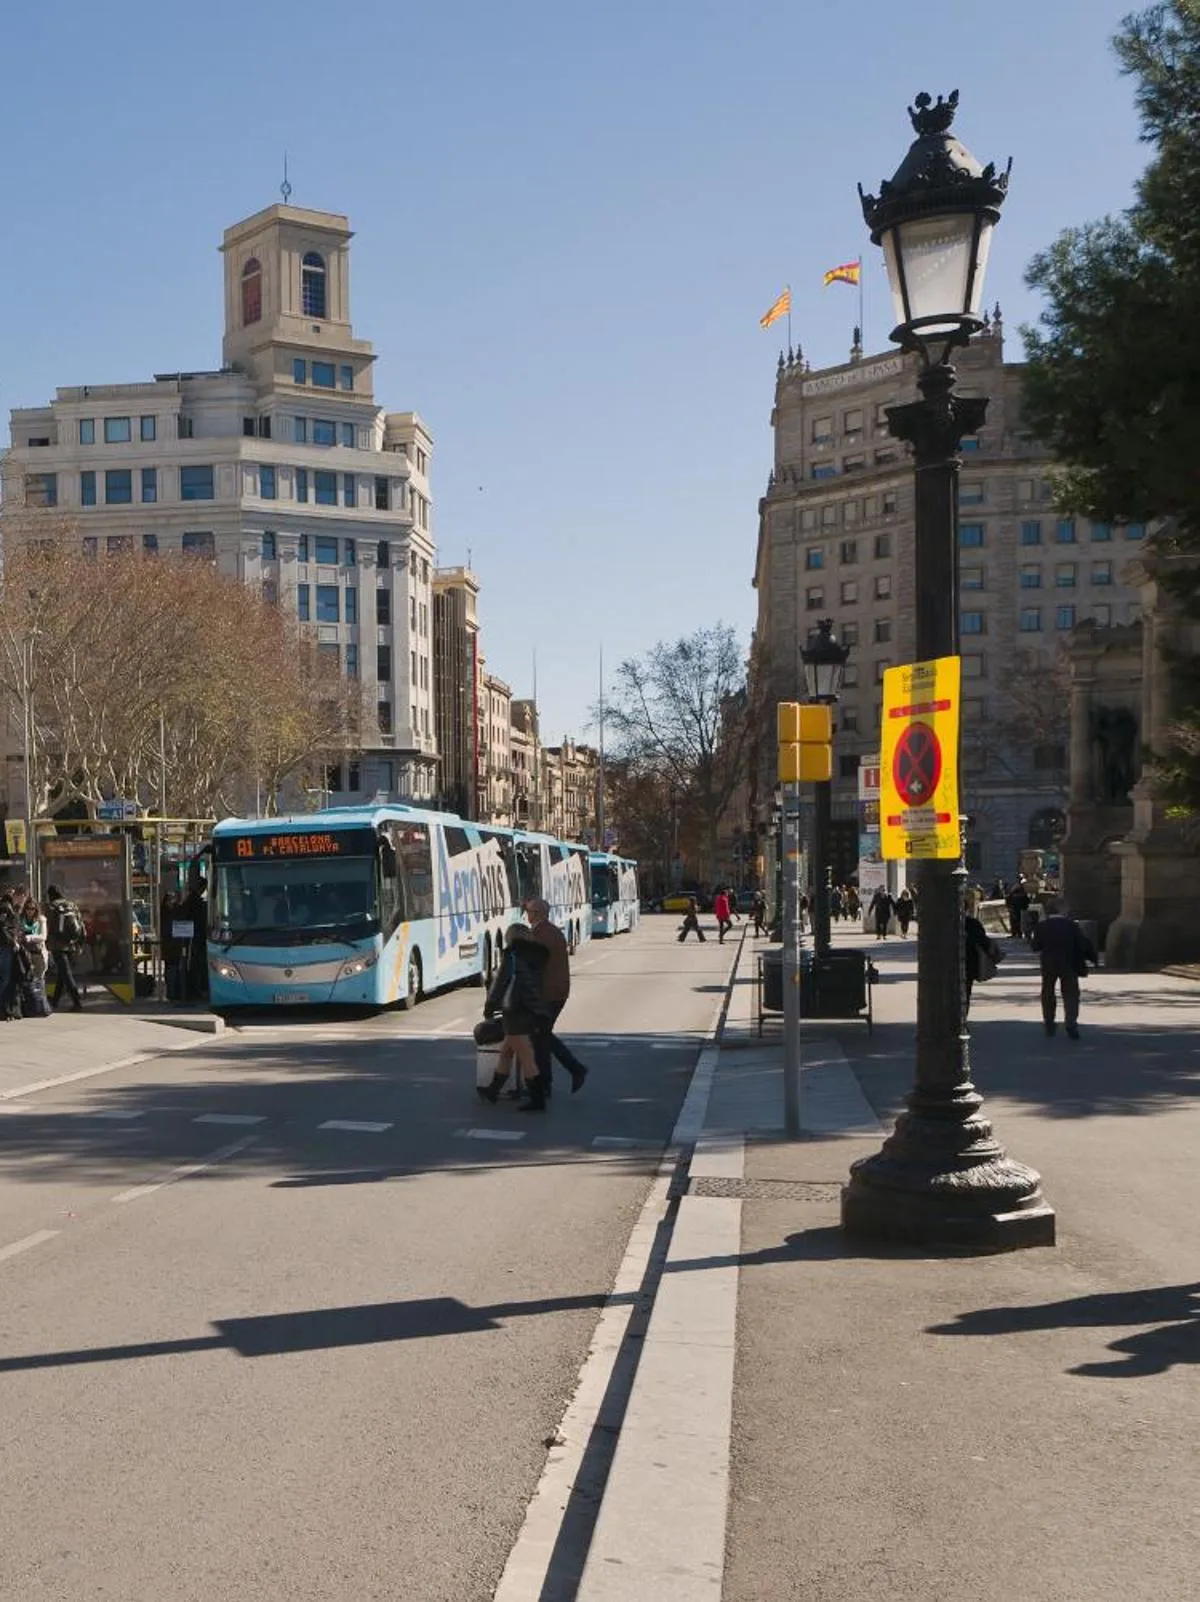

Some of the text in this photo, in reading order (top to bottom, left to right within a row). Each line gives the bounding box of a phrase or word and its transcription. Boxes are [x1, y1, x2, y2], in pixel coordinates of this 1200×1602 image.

[237, 839, 254, 857] A1
[271, 834, 331, 847] BARCELONA
[437, 824, 505, 958] Aerobus
